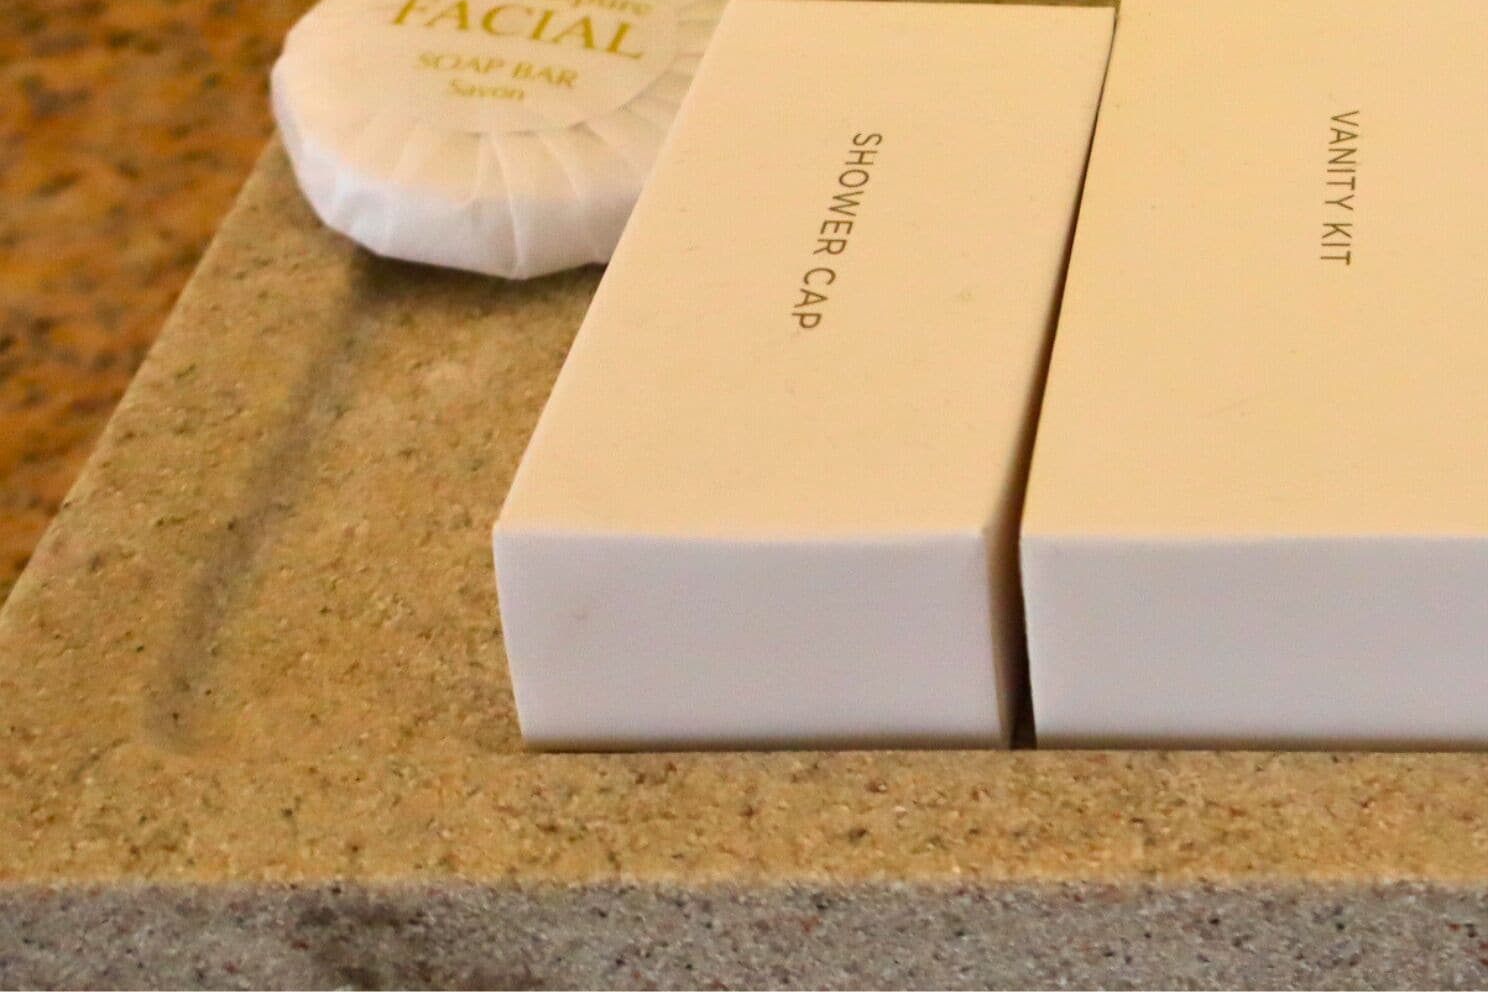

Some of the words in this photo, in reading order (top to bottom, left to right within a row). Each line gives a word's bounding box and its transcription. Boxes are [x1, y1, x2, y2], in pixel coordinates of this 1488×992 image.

[416, 51, 506, 75] SOAP
[511, 61, 579, 89] BAR
[1324, 110, 1360, 212] VANITY
[812, 132, 883, 256] SHOWER
[1320, 222, 1353, 266] KIT
[791, 267, 836, 330] CAP
